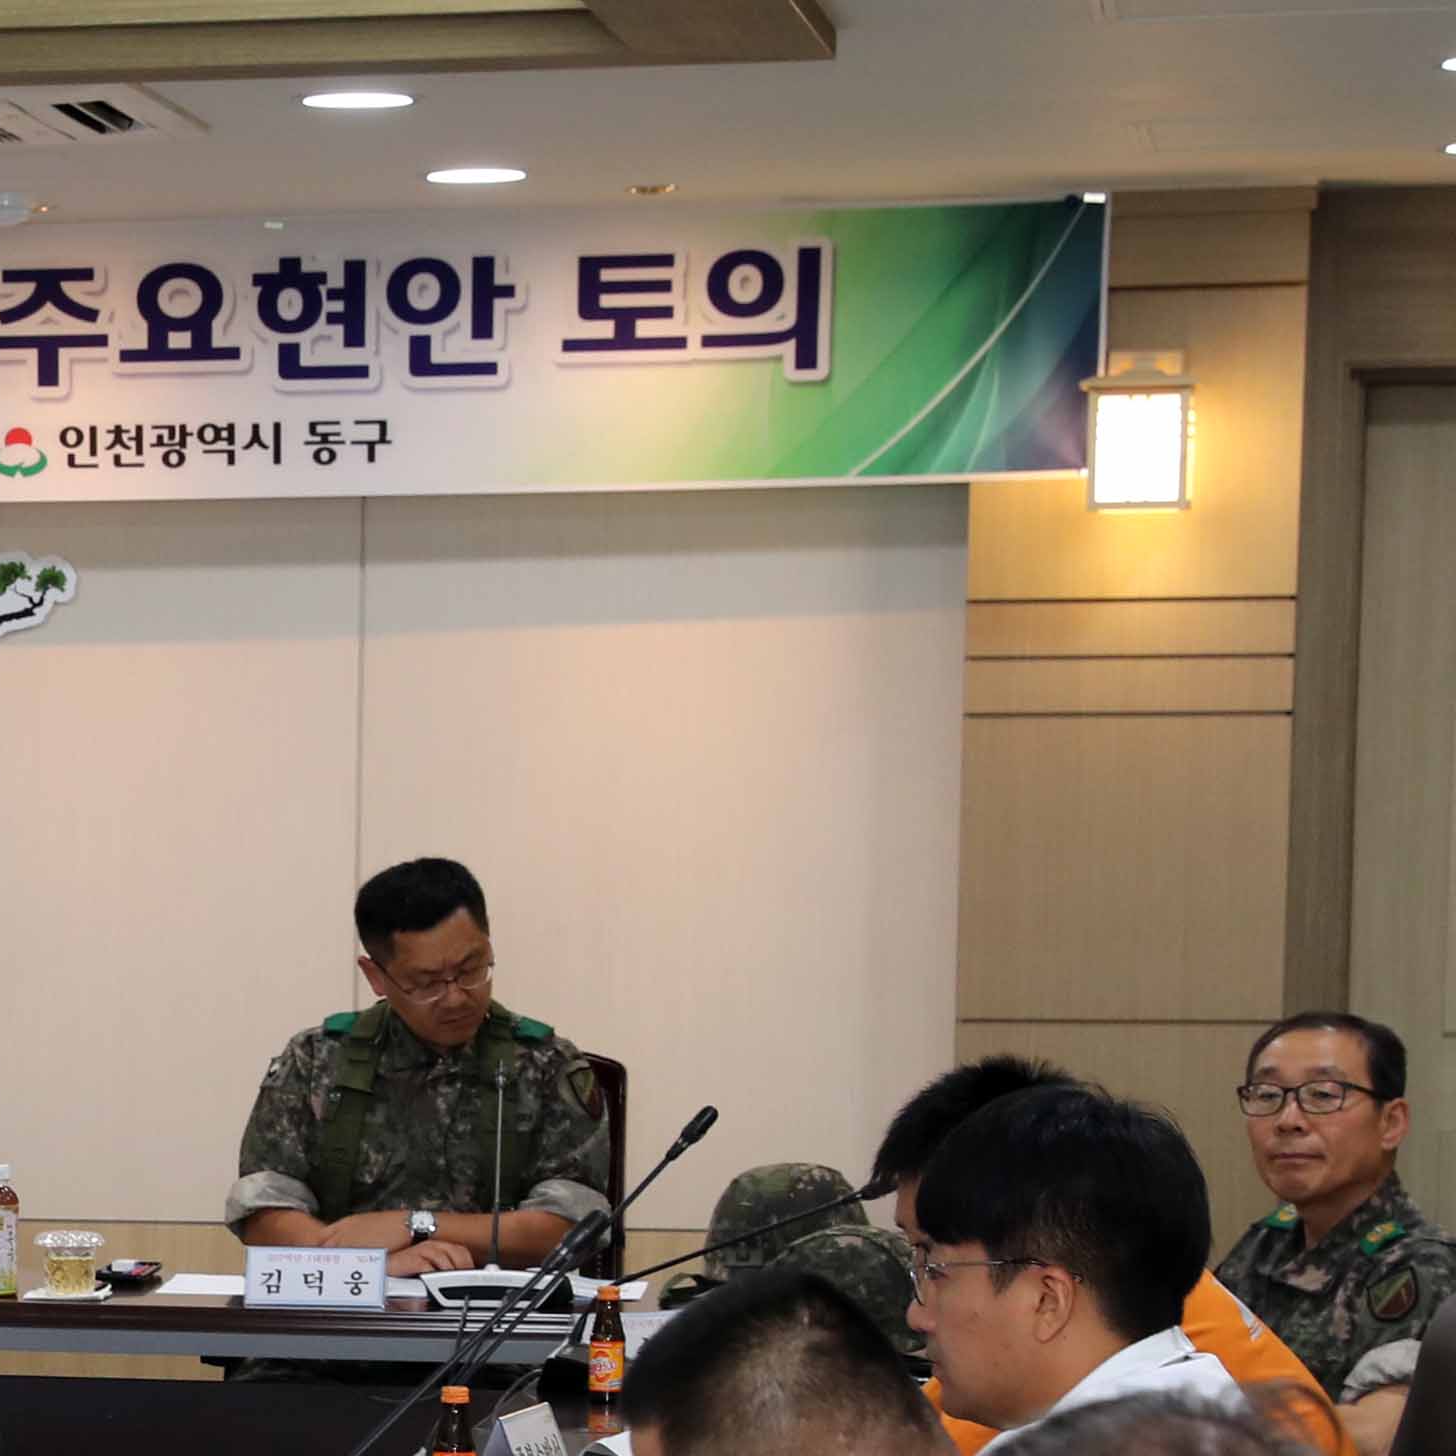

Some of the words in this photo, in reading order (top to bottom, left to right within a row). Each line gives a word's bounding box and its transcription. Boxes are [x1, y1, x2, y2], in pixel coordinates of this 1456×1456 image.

[561, 245, 823, 371] 토의
[59, 421, 283, 468] 인천광역시
[303, 418, 393, 467] 동구
[260, 1268, 370, 1297] 김덕웅
